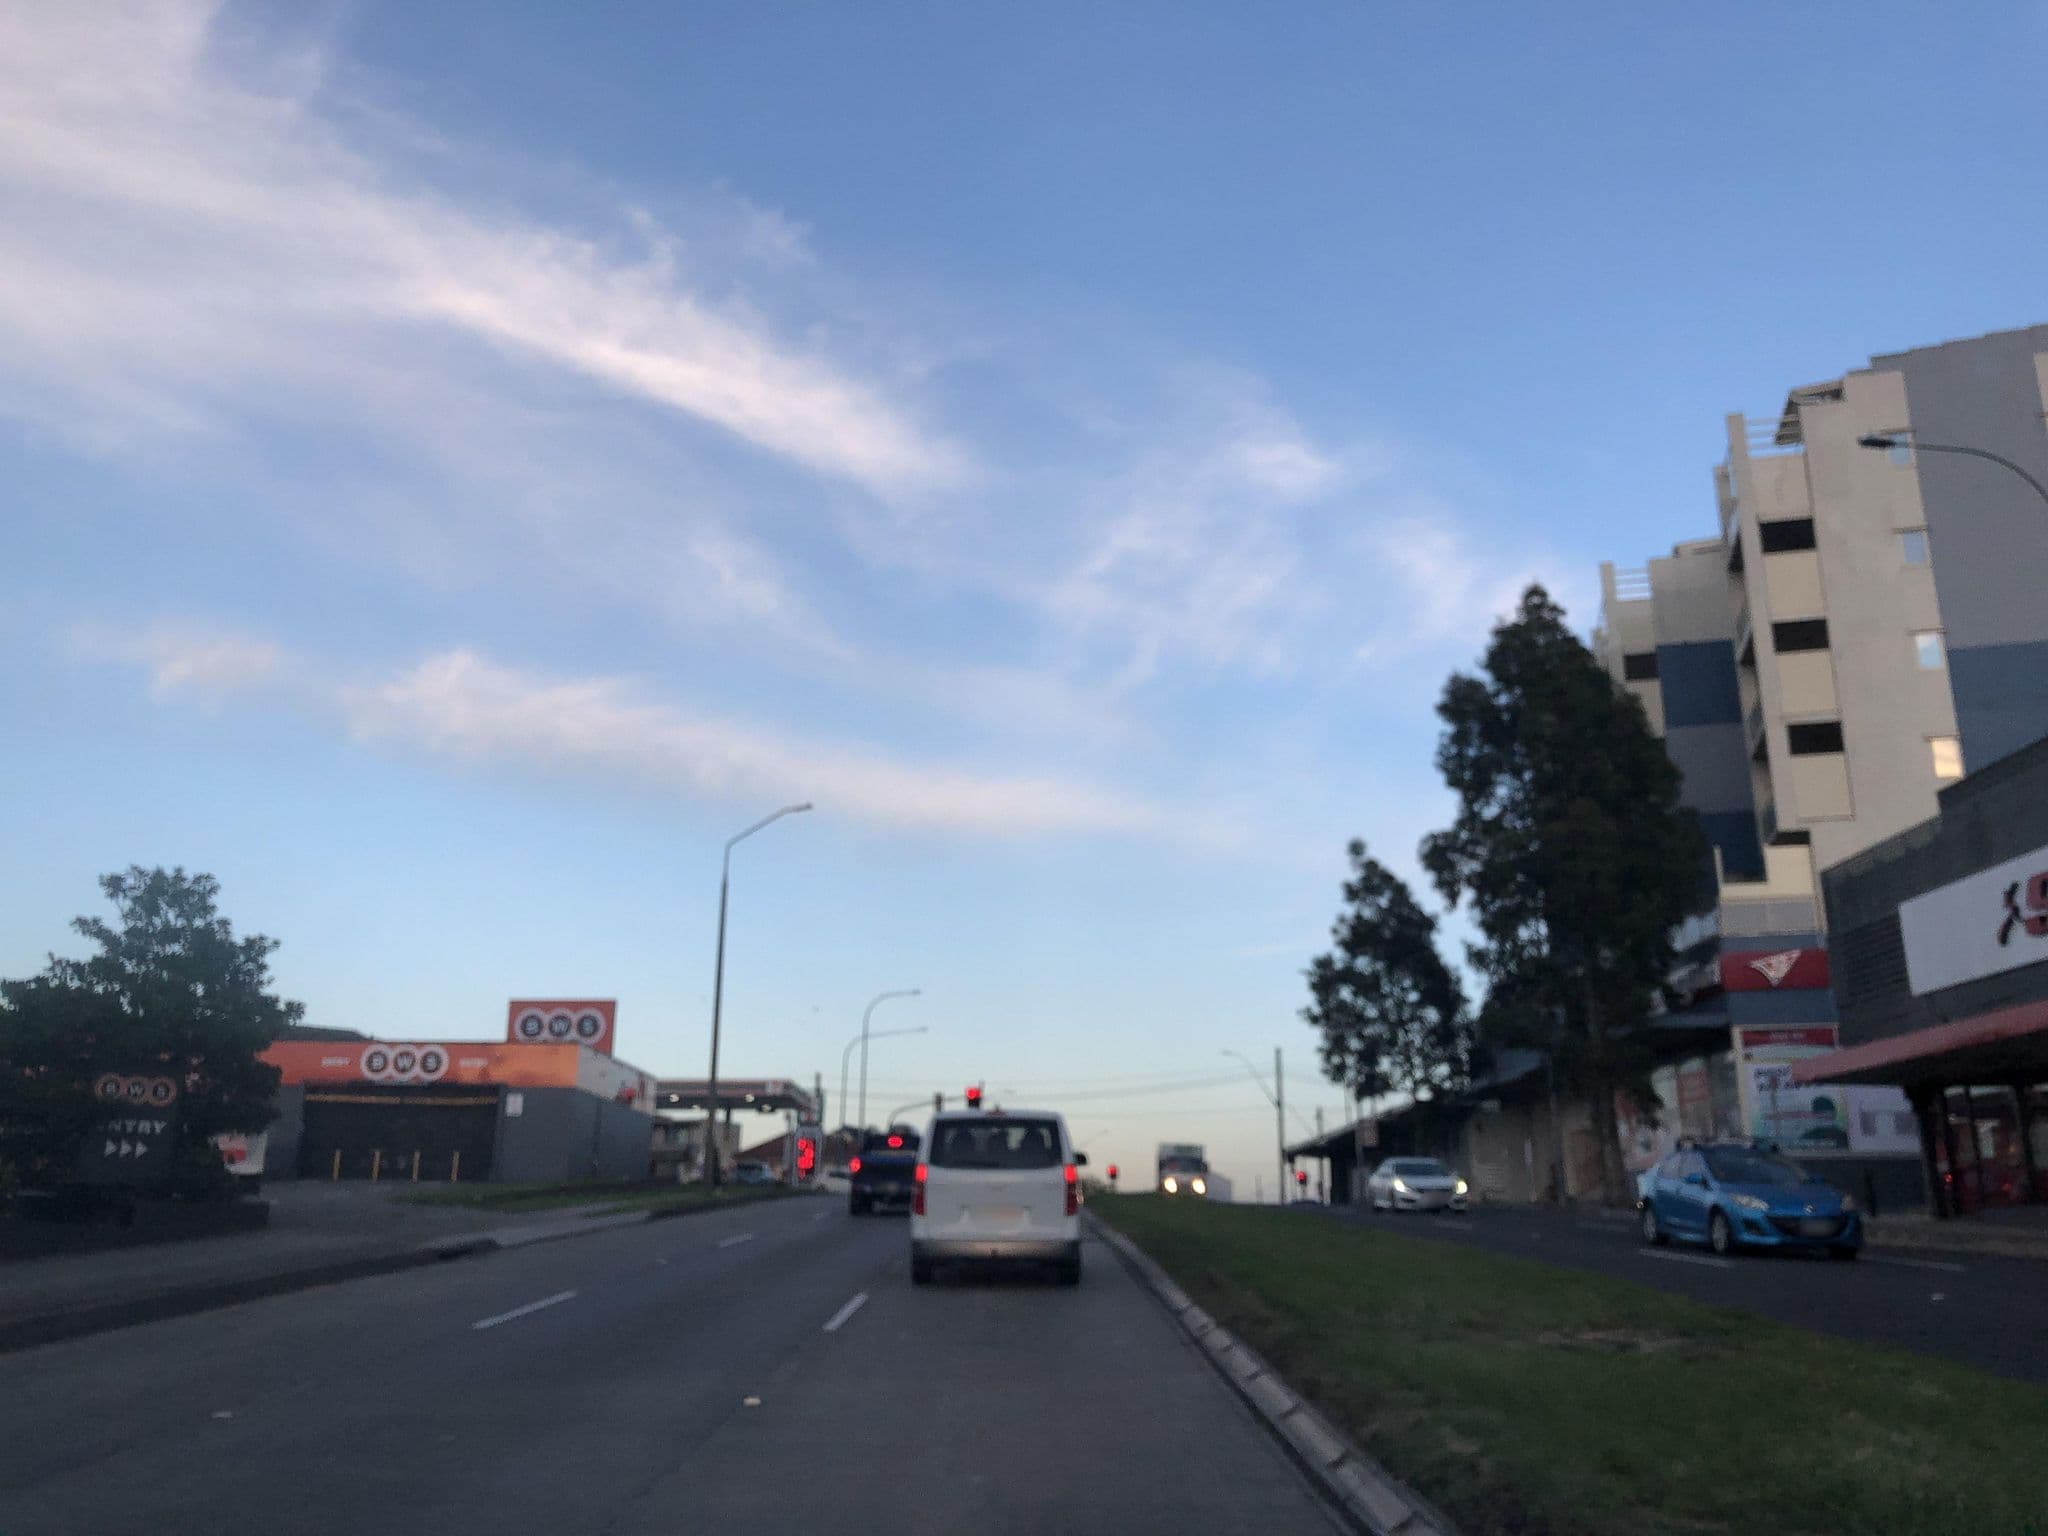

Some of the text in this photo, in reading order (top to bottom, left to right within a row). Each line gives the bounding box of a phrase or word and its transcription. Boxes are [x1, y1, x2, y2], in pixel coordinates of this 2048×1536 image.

[522, 1016, 595, 1035] BWS
[368, 1053, 441, 1071] BWS
[104, 1119, 168, 1135] NTRY
